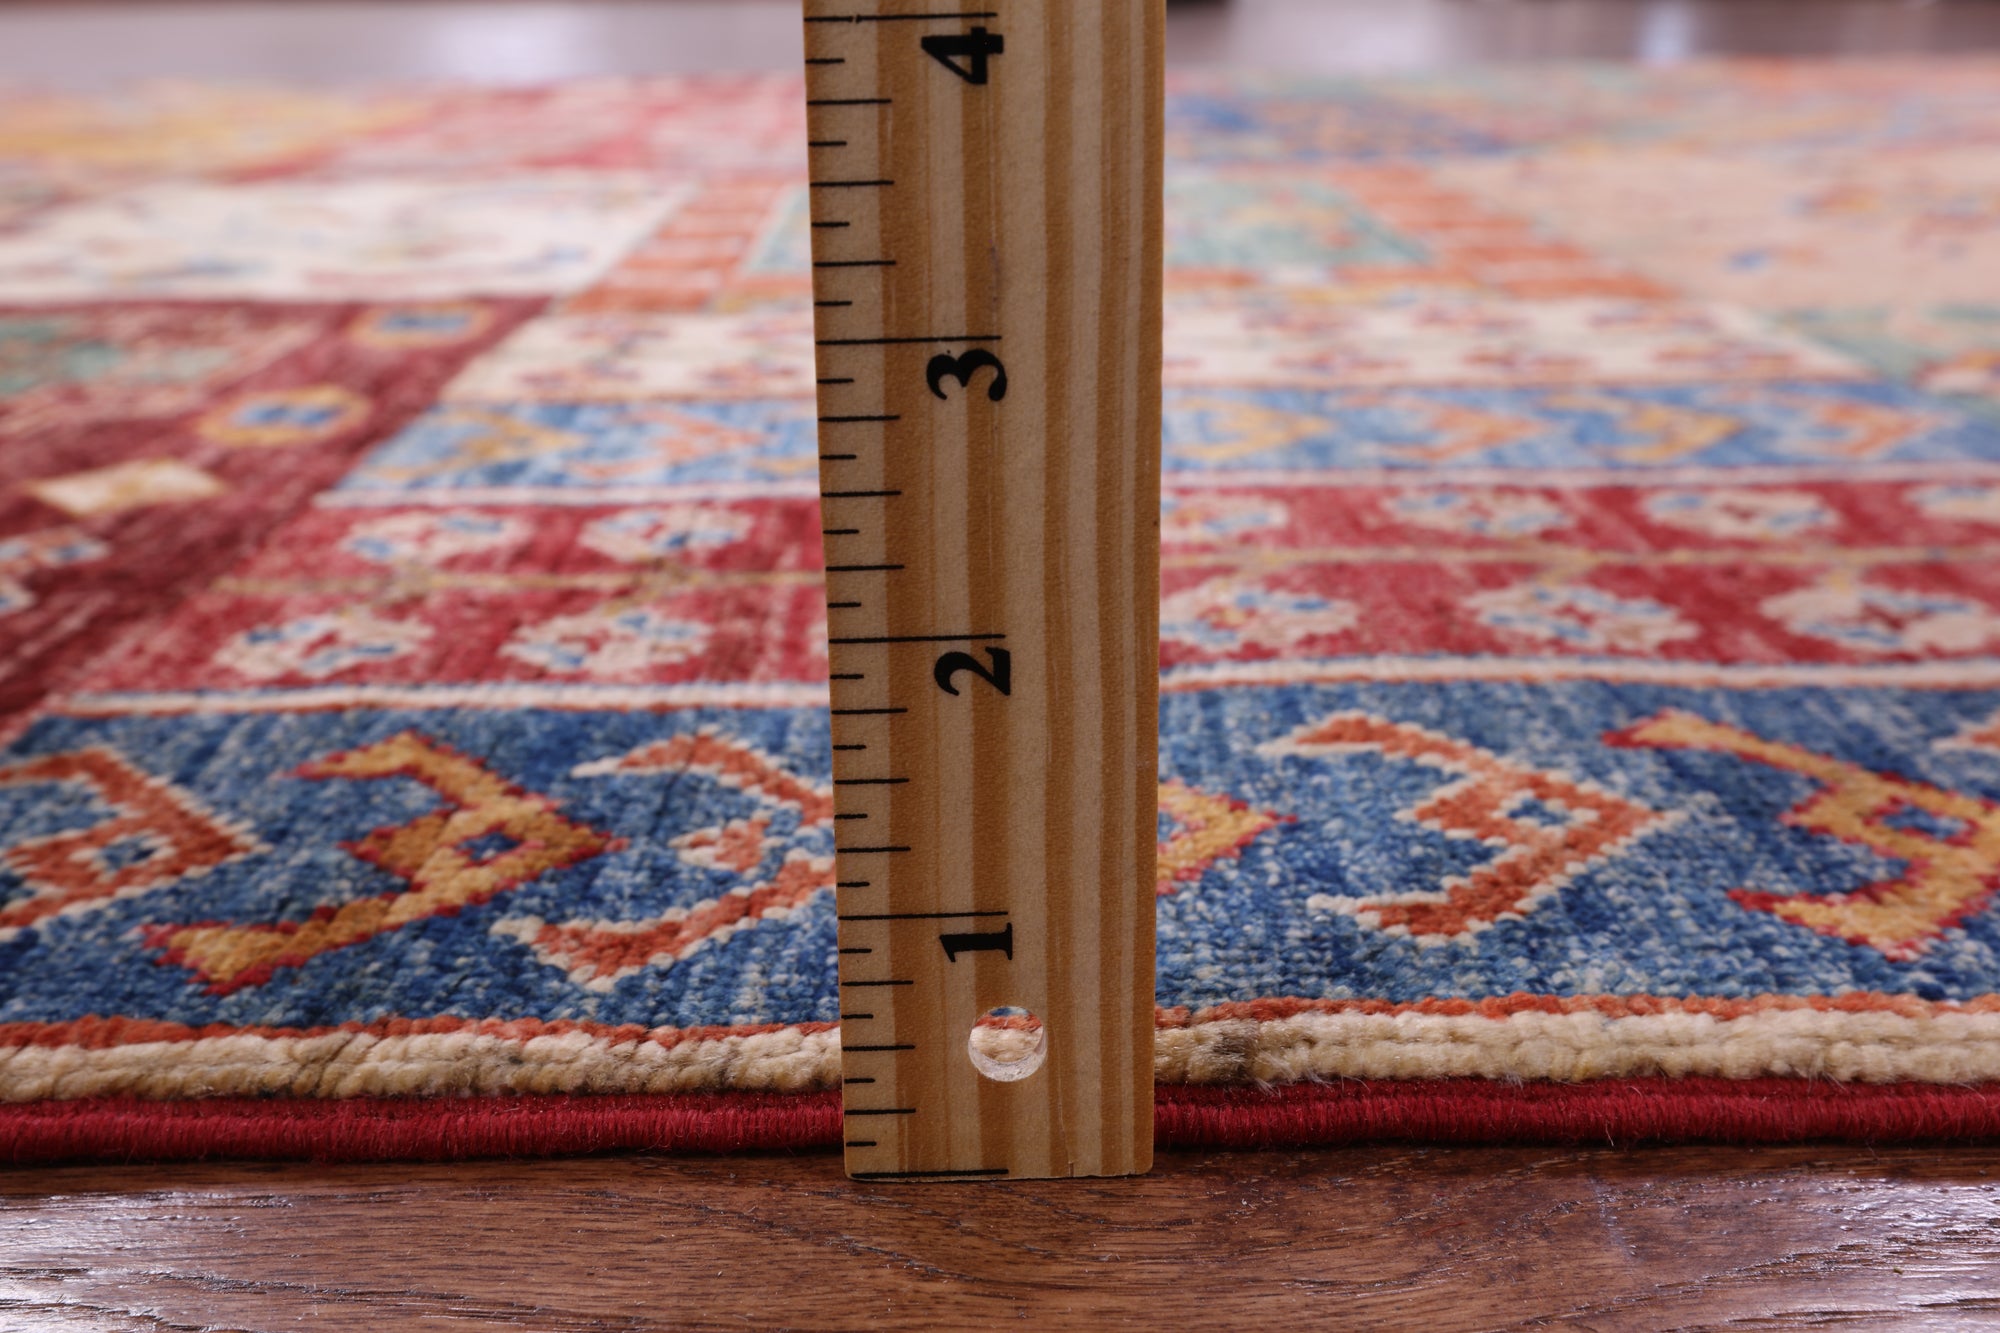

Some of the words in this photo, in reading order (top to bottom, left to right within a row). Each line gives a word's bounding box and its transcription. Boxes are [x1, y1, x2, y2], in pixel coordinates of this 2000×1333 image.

[921, 26, 1004, 86] 4
[926, 348, 1008, 402] 3
[934, 646, 1012, 697] 2
[939, 922, 1013, 963] 1
